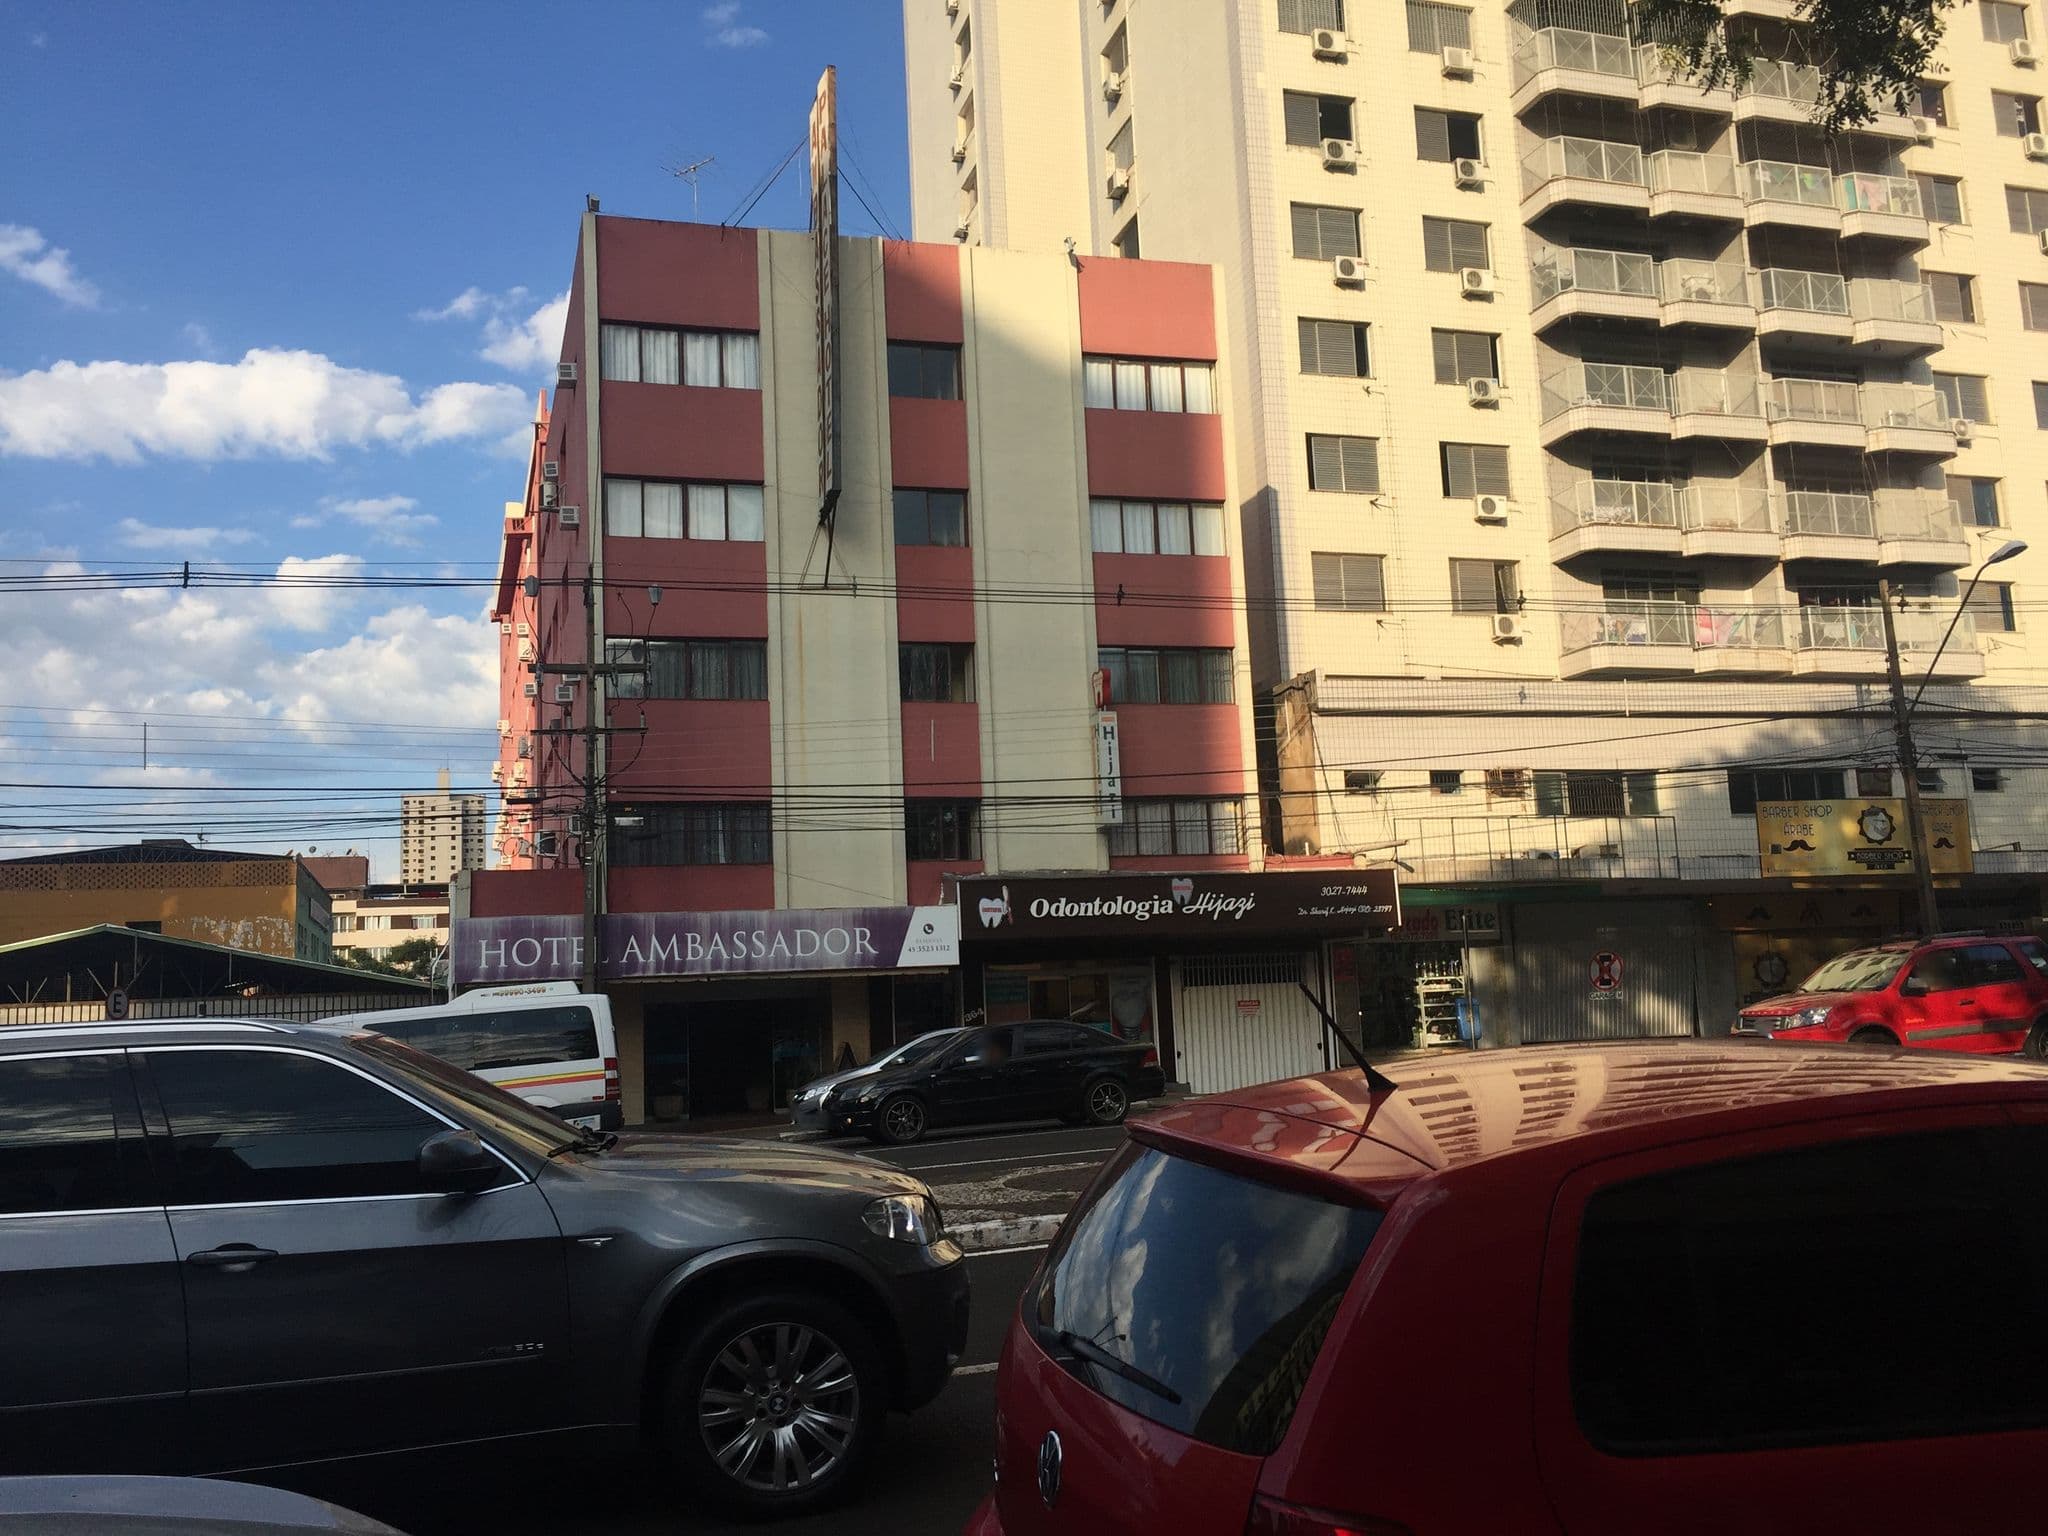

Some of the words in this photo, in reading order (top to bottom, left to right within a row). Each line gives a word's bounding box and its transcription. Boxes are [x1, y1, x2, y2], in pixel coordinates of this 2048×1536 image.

[822, 303, 833, 481] HOTEL
[1102, 725, 1116, 819] Hijazi
[1762, 806, 1799, 818] BARBER
[1803, 804, 1832, 818] SHOP
[1320, 886, 1368, 897] 3027-7444
[1030, 895, 1174, 921] Odontologia
[1182, 892, 1255, 920] Hijazi
[479, 936, 609, 968] HOTEL
[619, 927, 879, 963] AMBASSADOR
[113, 993, 123, 1013] E
